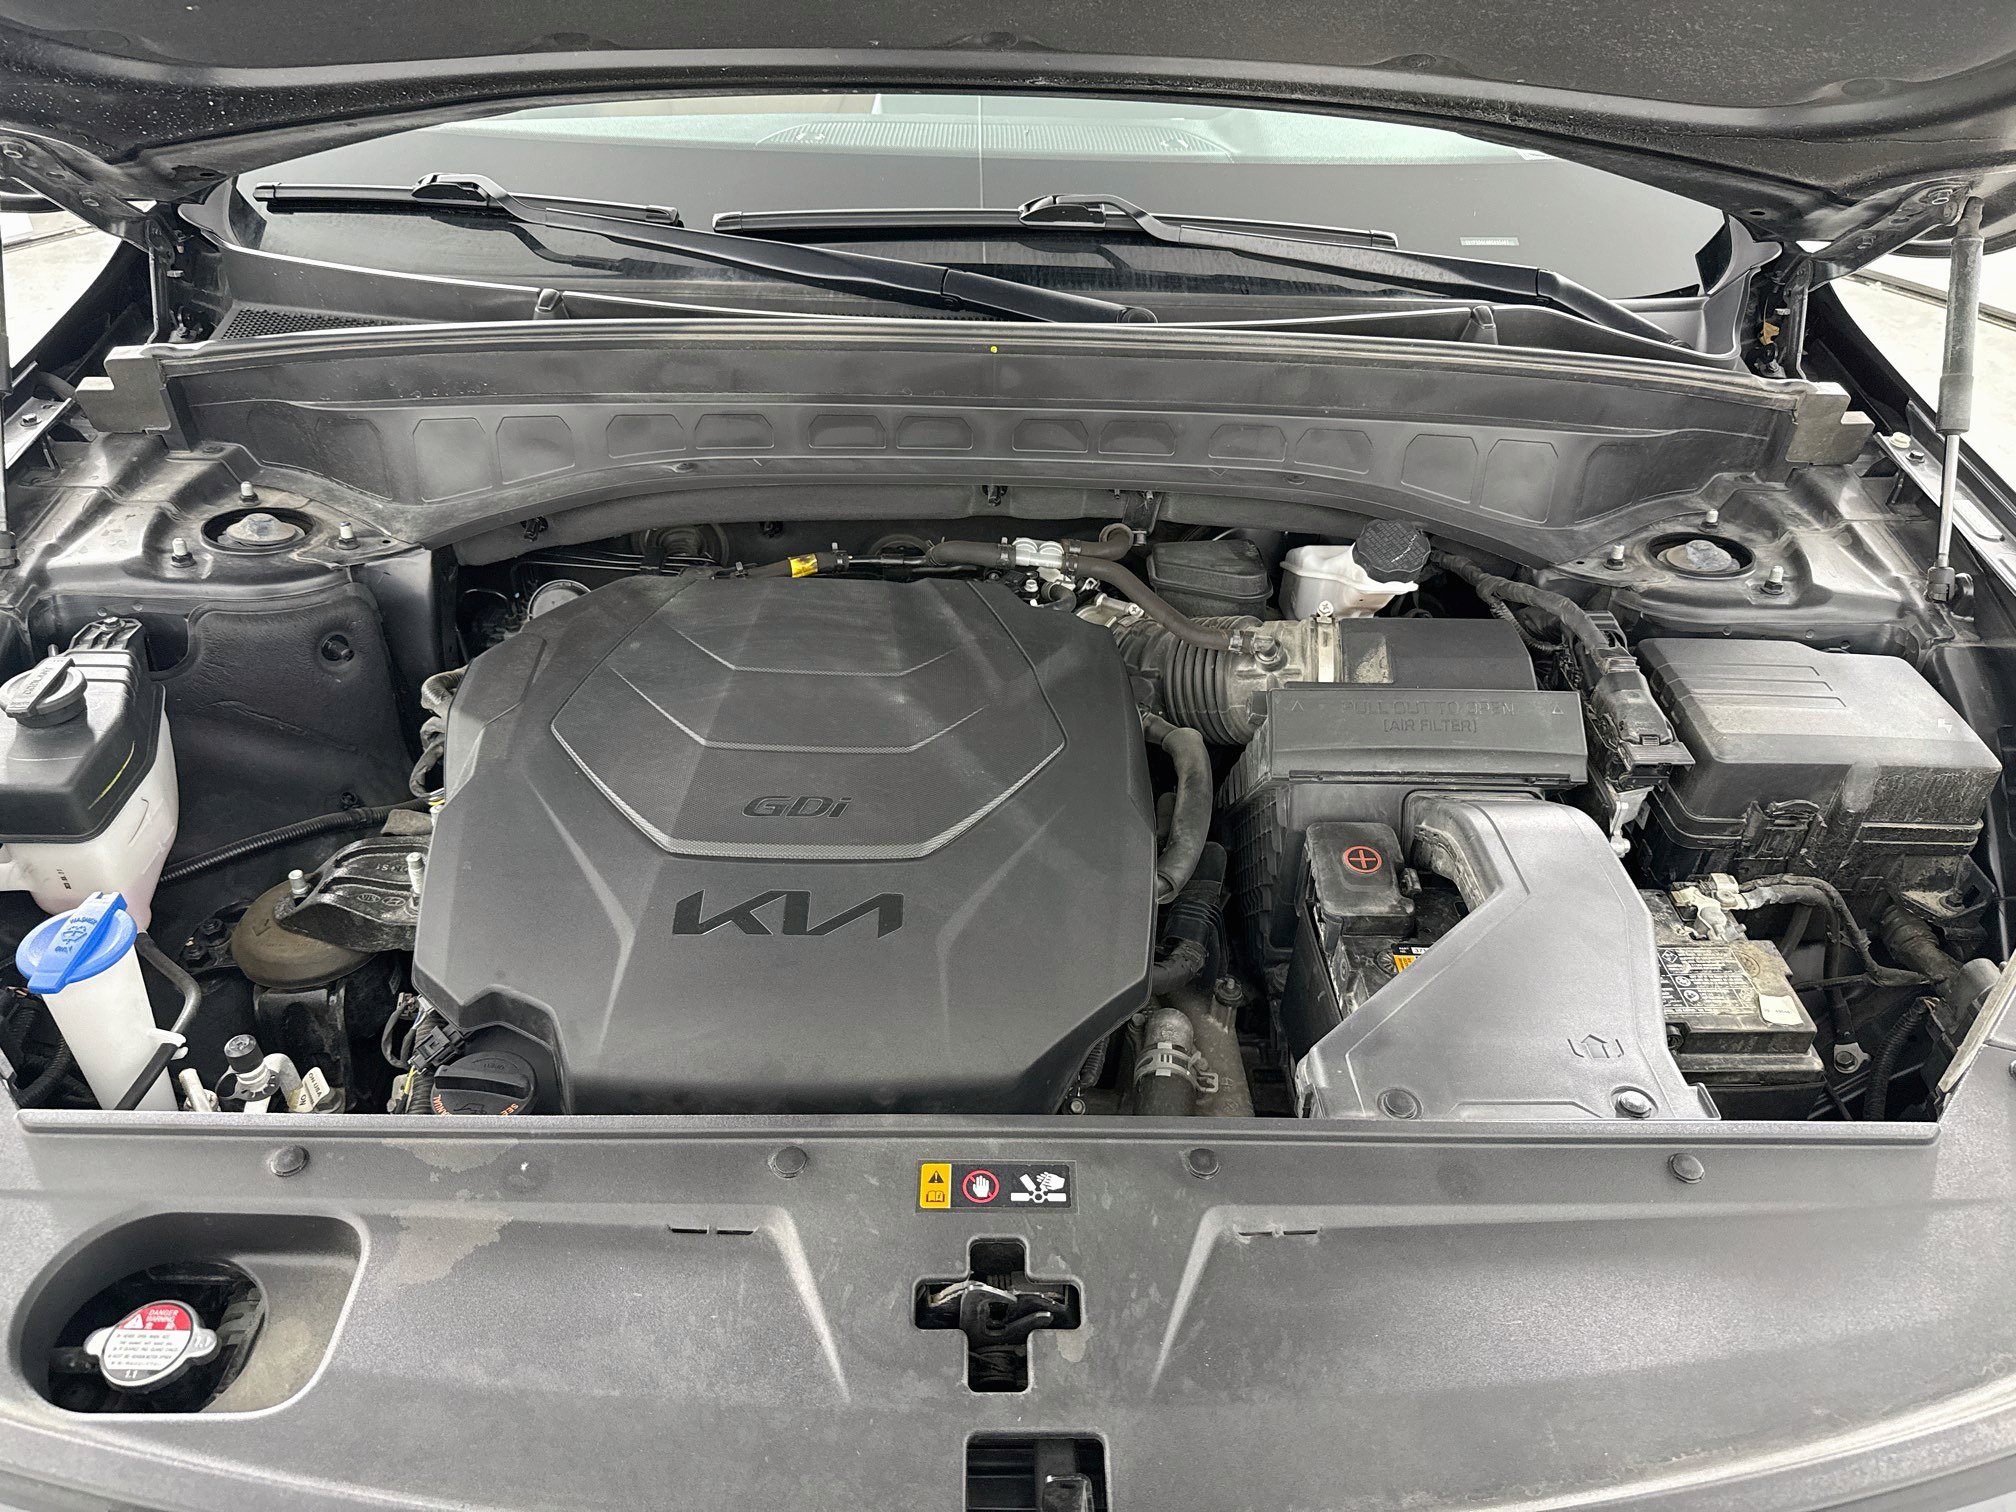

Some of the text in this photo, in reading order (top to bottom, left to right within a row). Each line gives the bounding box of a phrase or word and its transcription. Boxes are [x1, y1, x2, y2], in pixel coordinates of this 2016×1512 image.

[1342, 700, 1516, 715] PULL OUT TO OPEN
[742, 796, 852, 818] GDi
[672, 889, 904, 938] KIA
[500, 1103, 519, 1116] SEE
[145, 1315, 175, 1323] WARNING
[124, 1370, 138, 1379] 1.1
